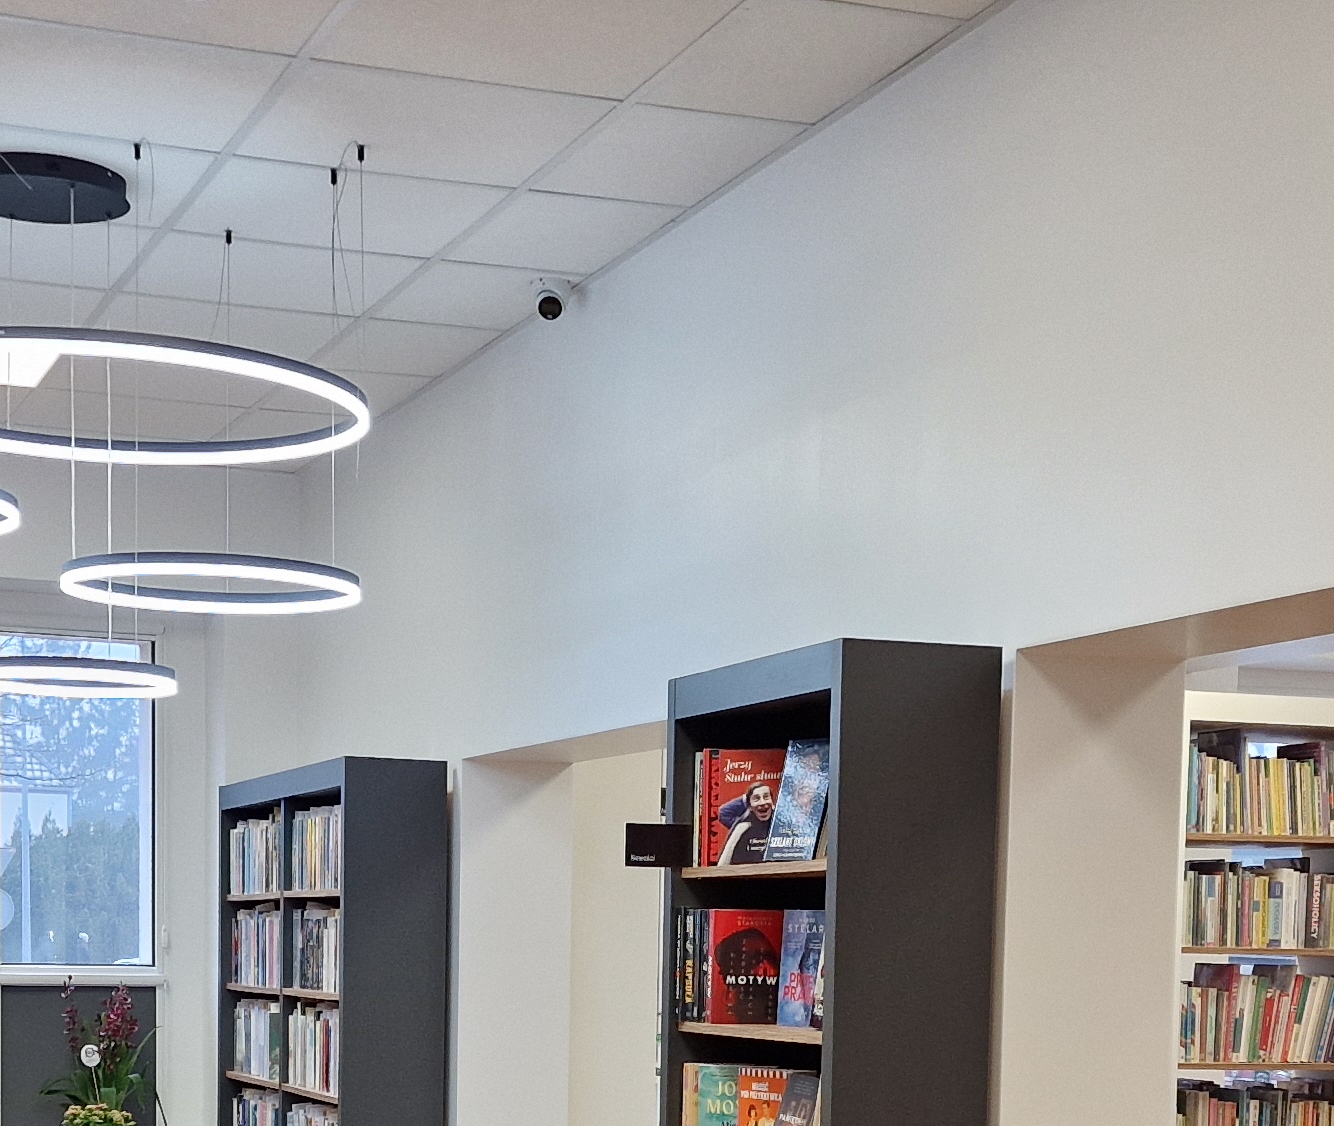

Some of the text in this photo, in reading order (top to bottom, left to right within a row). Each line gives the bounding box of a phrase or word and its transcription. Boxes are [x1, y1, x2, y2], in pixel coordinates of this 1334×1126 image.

[723, 759, 753, 774] Jerzy
[725, 771, 755, 784] Stuhr
[787, 923, 825, 934] STELAR
[725, 975, 778, 986] MOTYW
[715, 1080, 738, 1097] JO
[707, 1098, 738, 1115] MO
